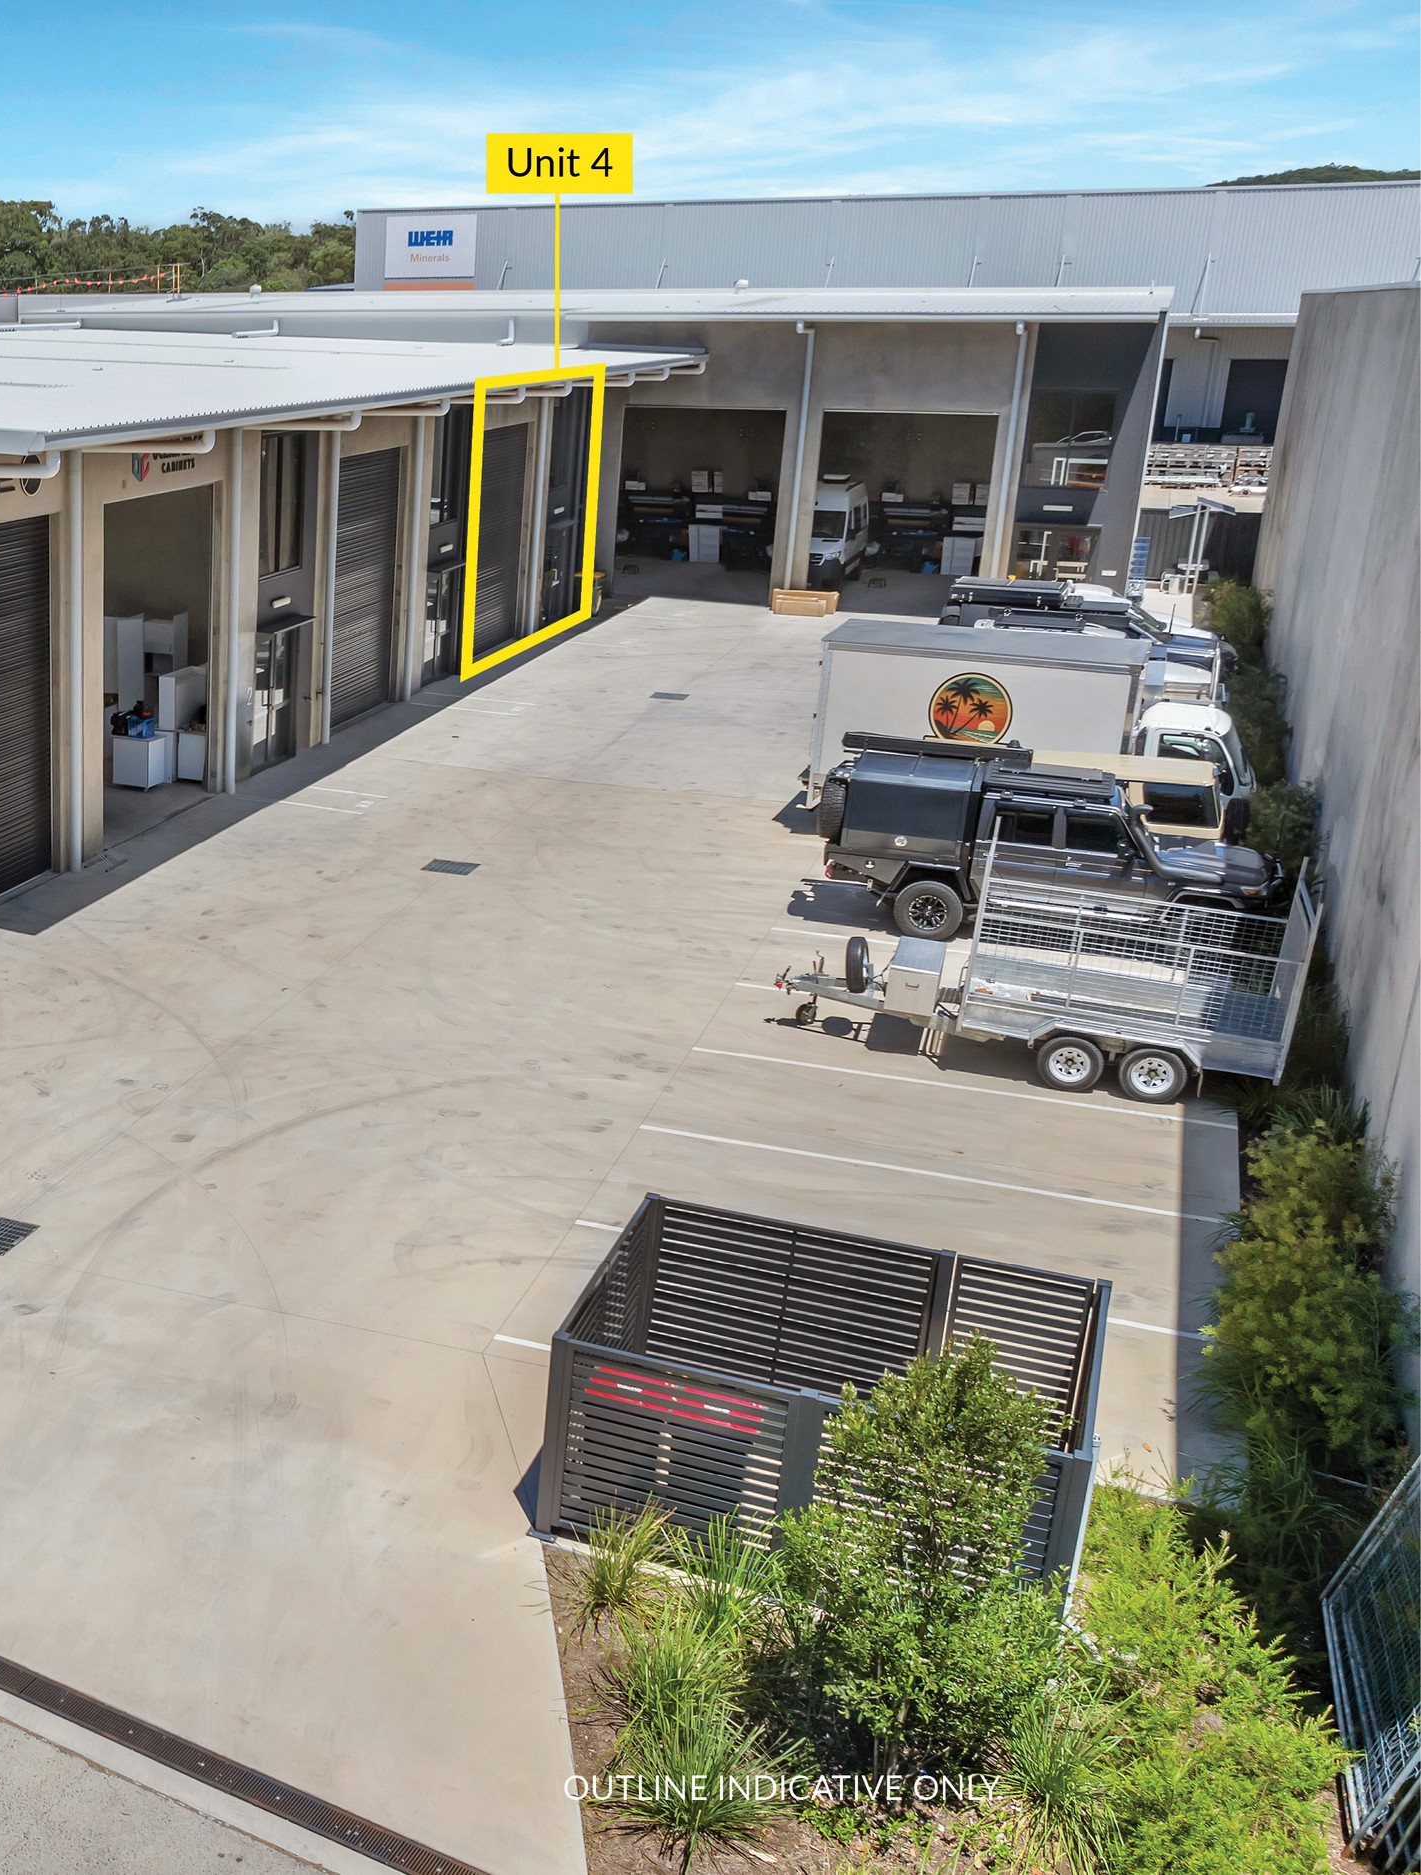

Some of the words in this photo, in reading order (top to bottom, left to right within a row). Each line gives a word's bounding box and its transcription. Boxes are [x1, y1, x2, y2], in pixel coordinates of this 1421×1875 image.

[407, 229, 454, 247] WEIR
[409, 253, 450, 263] Minerals
[161, 458, 196, 474] CABINETS
